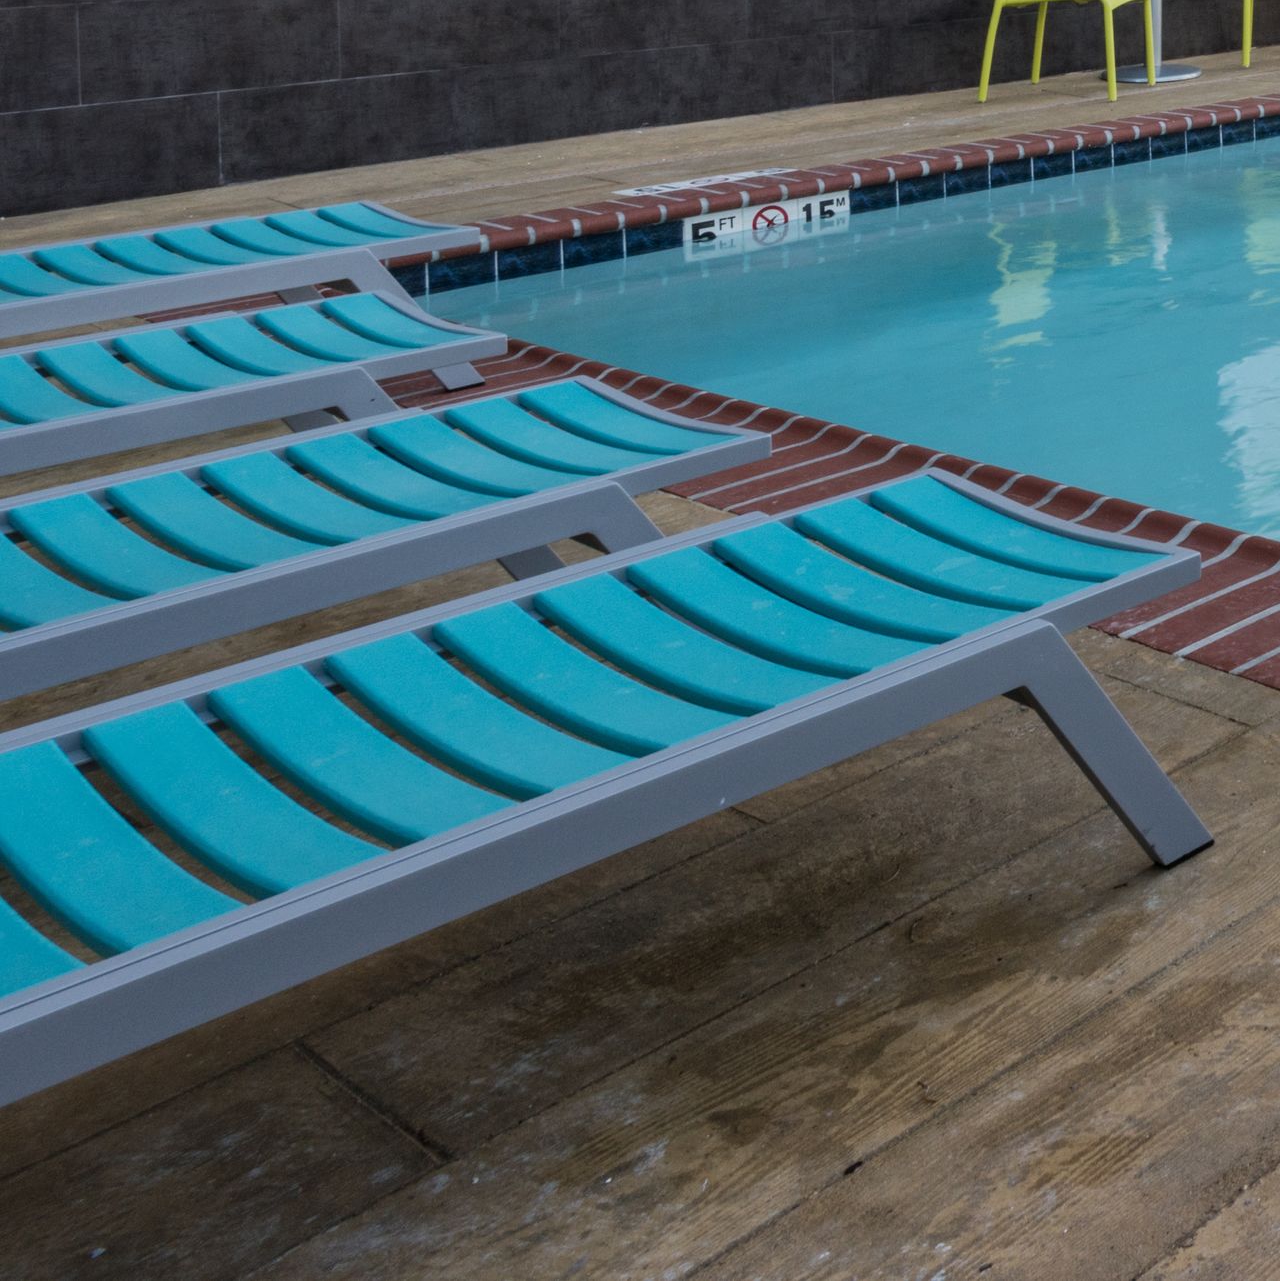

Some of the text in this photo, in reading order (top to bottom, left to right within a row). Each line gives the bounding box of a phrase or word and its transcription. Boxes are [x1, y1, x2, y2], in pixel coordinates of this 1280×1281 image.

[691, 219, 718, 243] 5
[718, 215, 737, 231] FT
[835, 196, 847, 207] M
